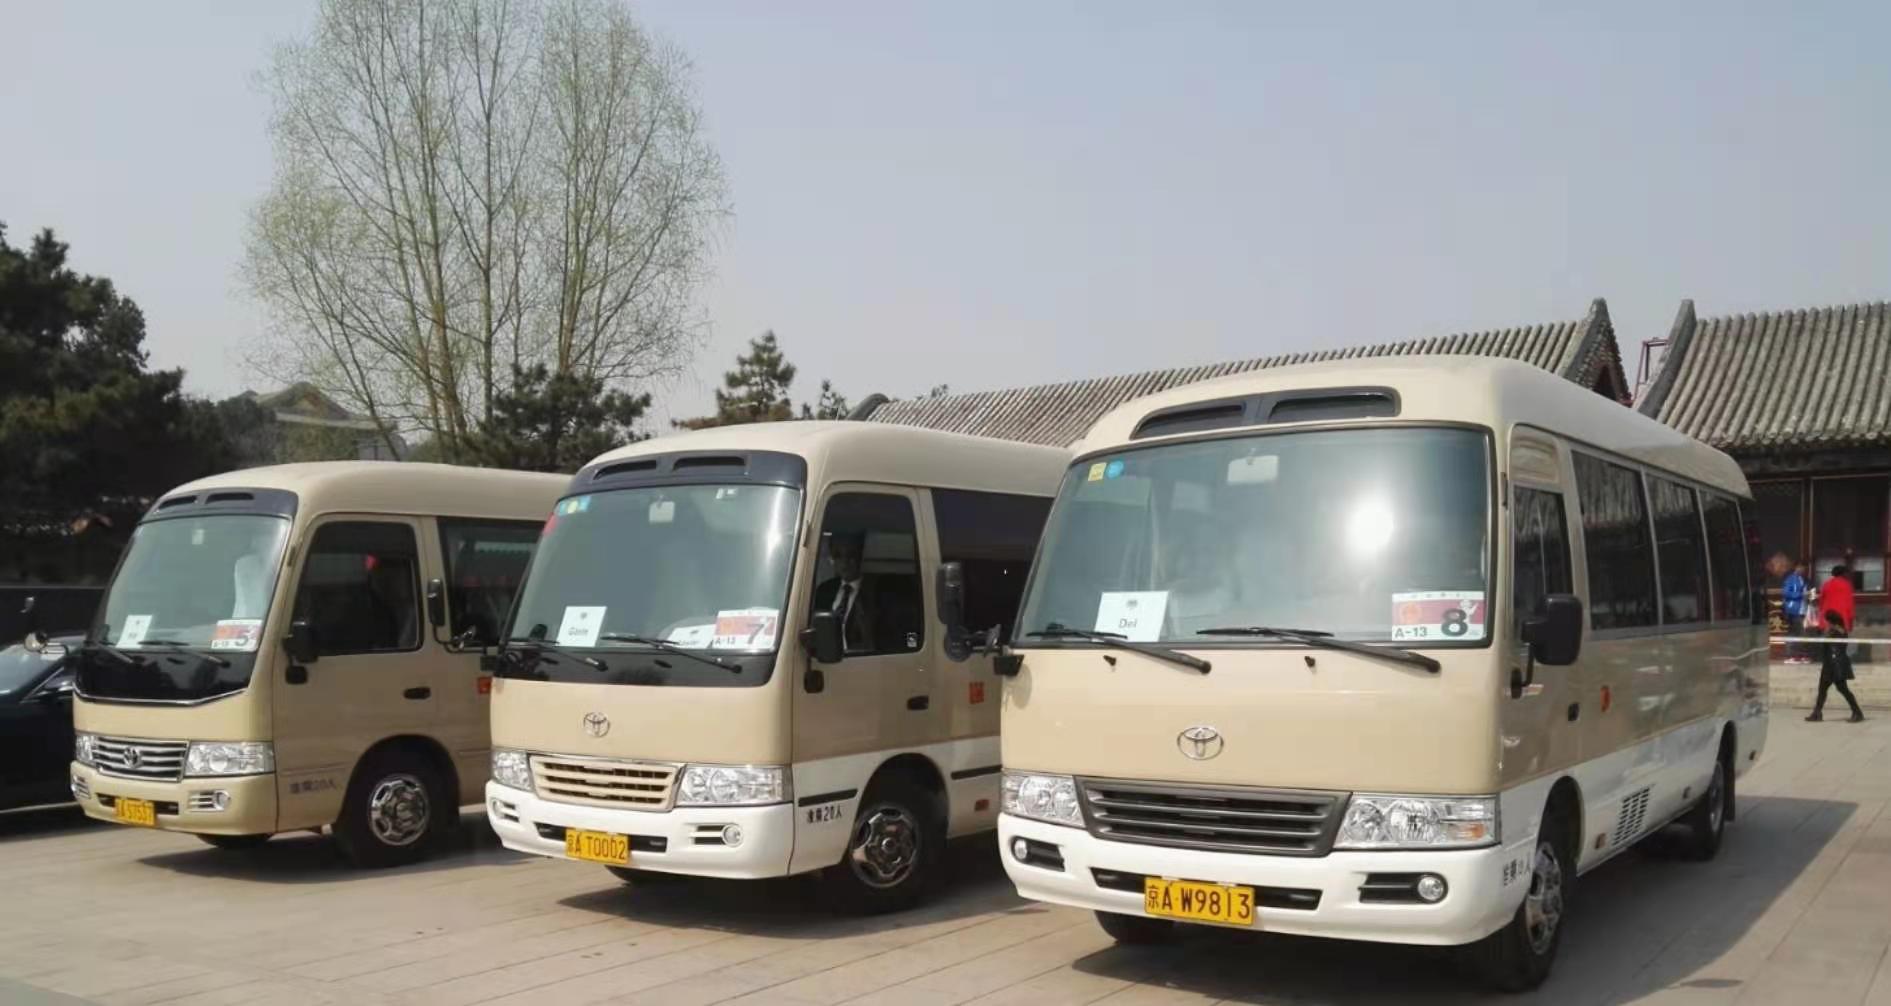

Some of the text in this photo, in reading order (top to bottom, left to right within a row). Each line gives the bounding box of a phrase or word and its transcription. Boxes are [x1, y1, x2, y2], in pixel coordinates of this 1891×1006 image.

[747, 622, 765, 645] 7
[1395, 627, 1427, 638] A-13
[1441, 608, 1468, 637] 8
